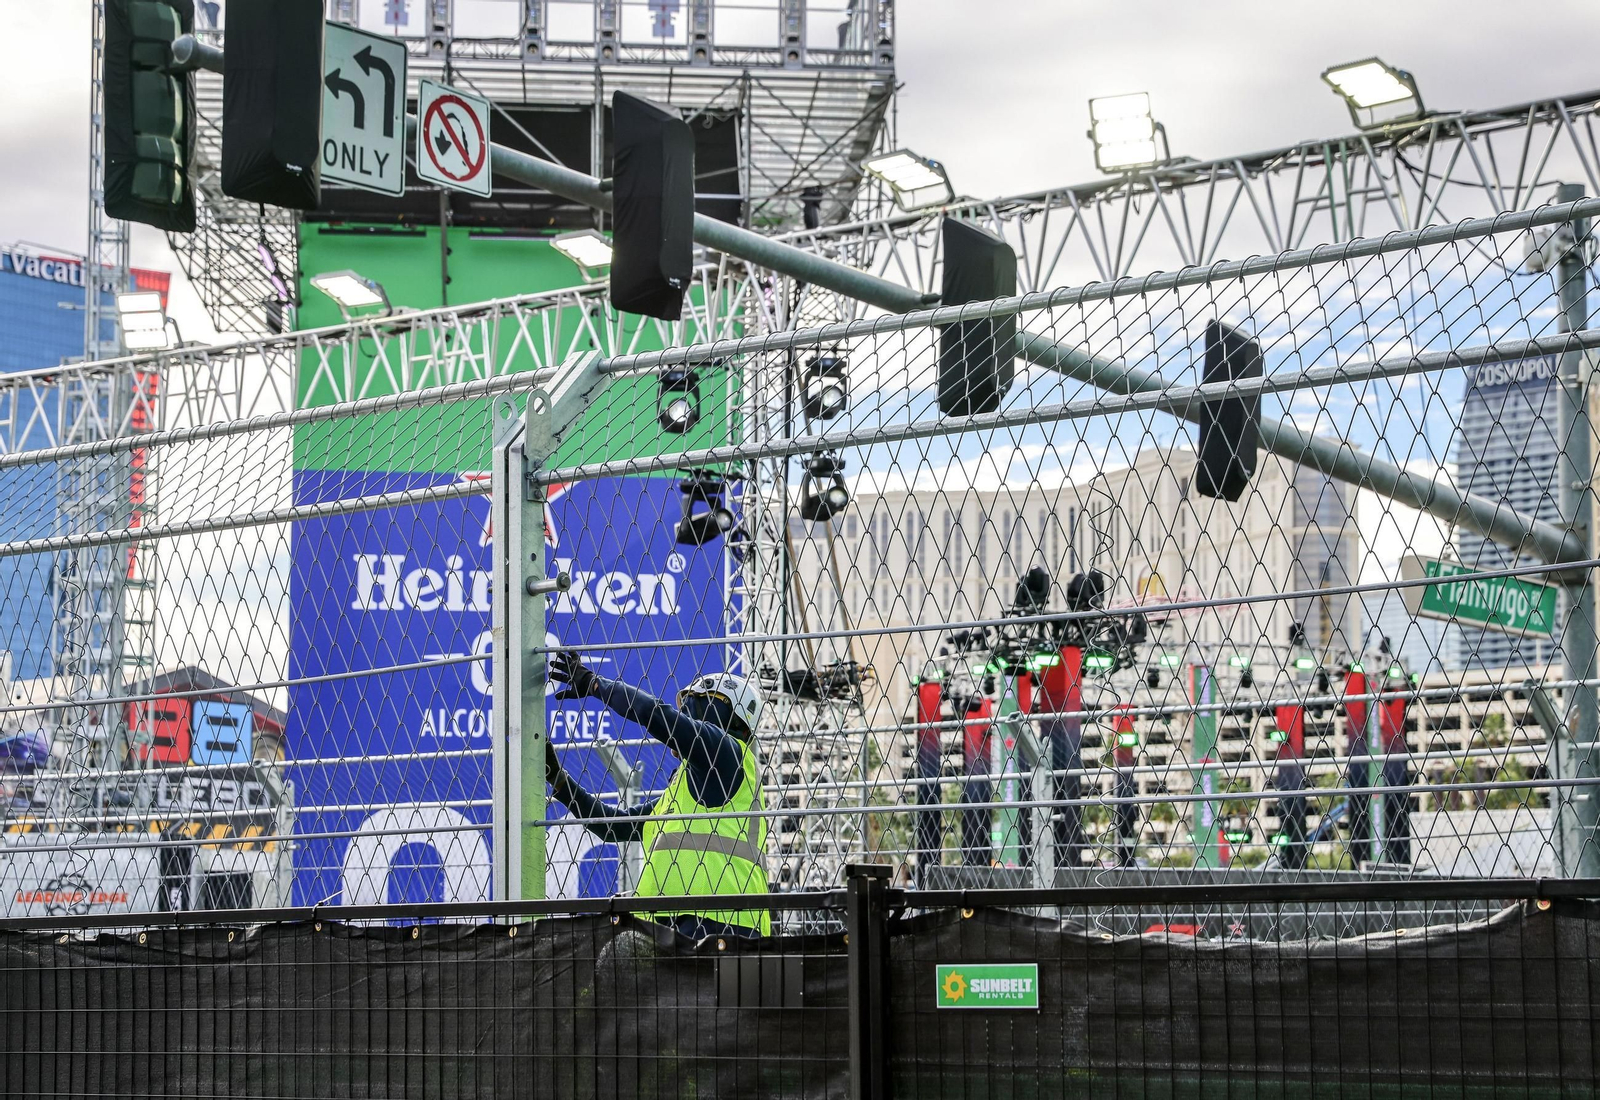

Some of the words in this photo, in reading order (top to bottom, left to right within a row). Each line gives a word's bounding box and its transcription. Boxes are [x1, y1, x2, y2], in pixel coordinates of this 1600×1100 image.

[323, 138, 390, 179] ONLY
[11, 247, 117, 292] Vacati
[1475, 357, 1556, 388] COSMOPOL
[1436, 564, 1528, 627] Flamingo
[421, 708, 493, 739] ALCO
[551, 709, 611, 739] FREE
[970, 979, 1032, 992] SUNBELT
